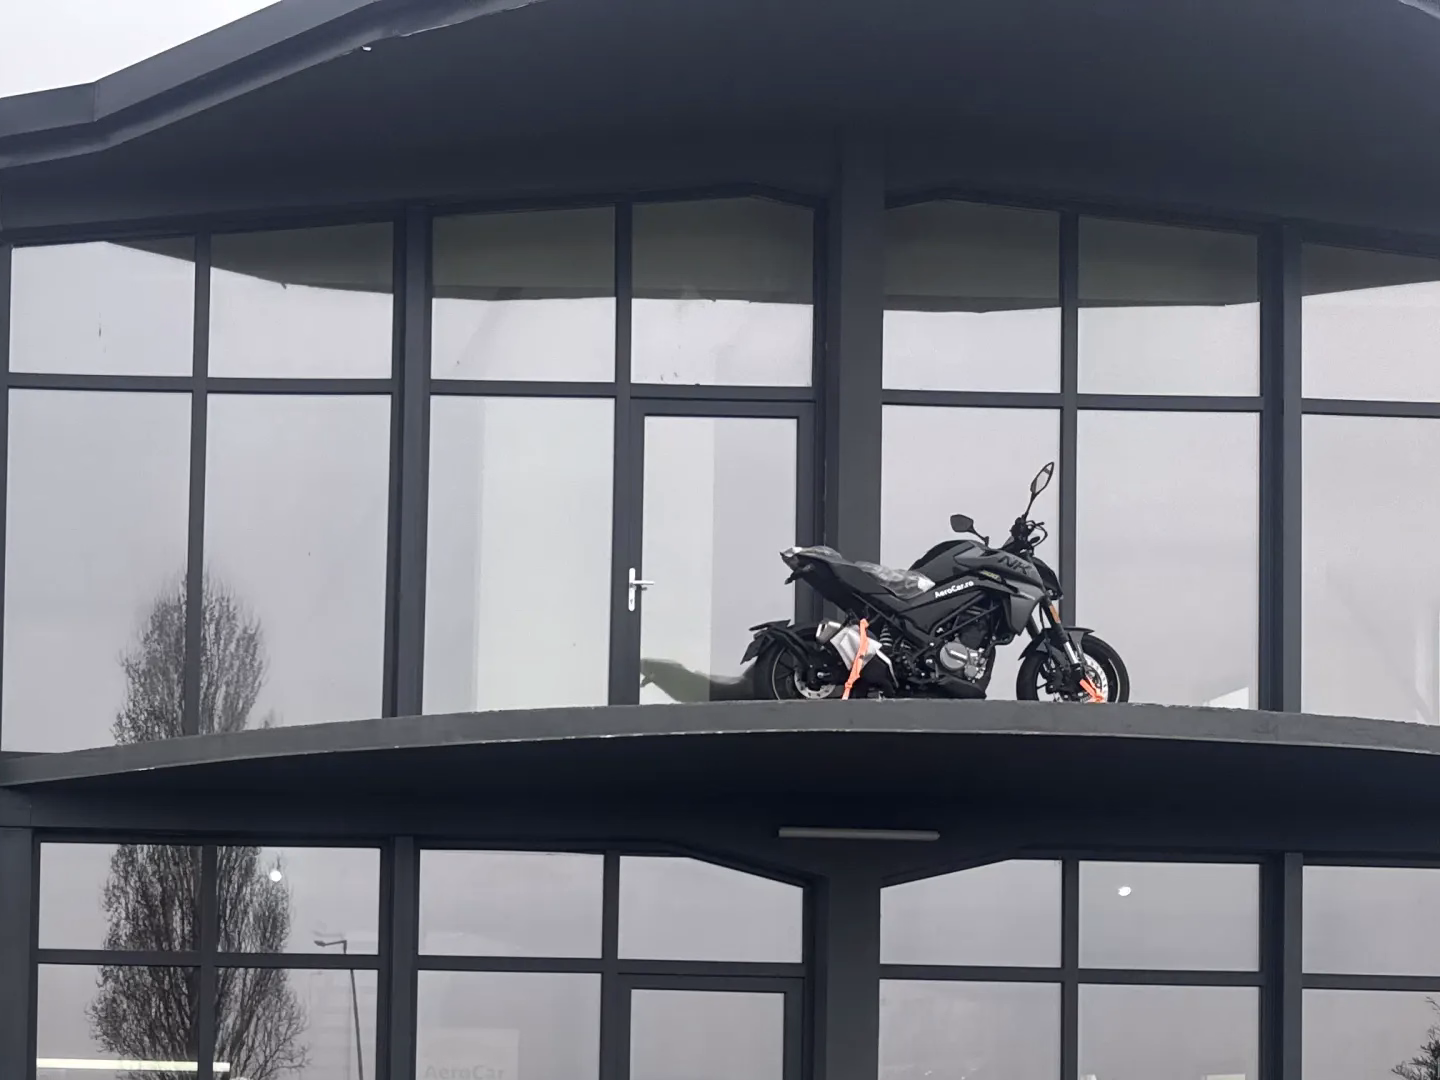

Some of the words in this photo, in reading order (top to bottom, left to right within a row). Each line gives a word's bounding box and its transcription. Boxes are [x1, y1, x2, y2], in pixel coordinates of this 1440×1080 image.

[997, 556, 1032, 575] NK
[934, 580, 974, 598] AeroCar.ro
[425, 1064, 505, 1080] AeroCar
